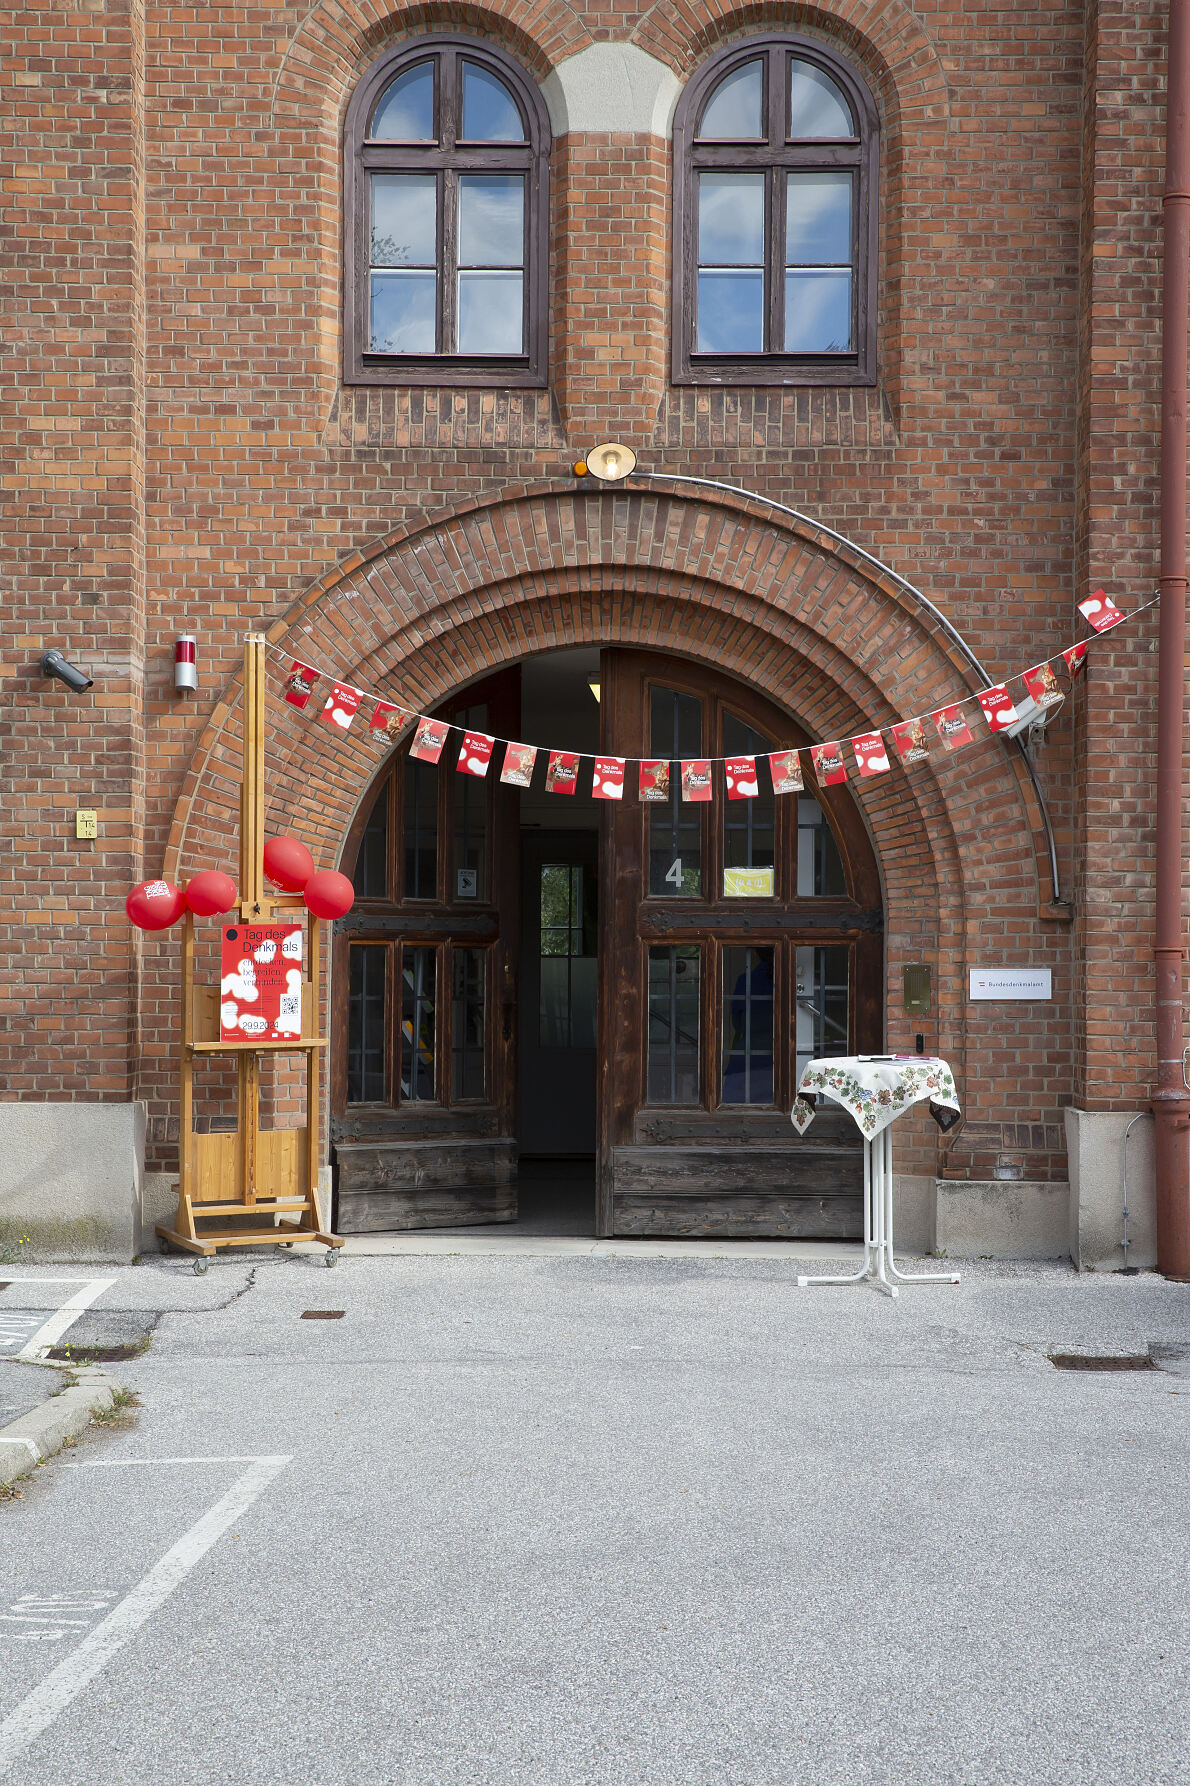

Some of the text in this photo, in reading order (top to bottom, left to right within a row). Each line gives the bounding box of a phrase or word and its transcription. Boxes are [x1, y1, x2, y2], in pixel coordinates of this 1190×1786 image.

[666, 858, 684, 888] 4
[244, 929, 286, 942] Tag des
[243, 941, 298, 952] Denkmals
[242, 1021, 278, 1030] 29.9.2024
